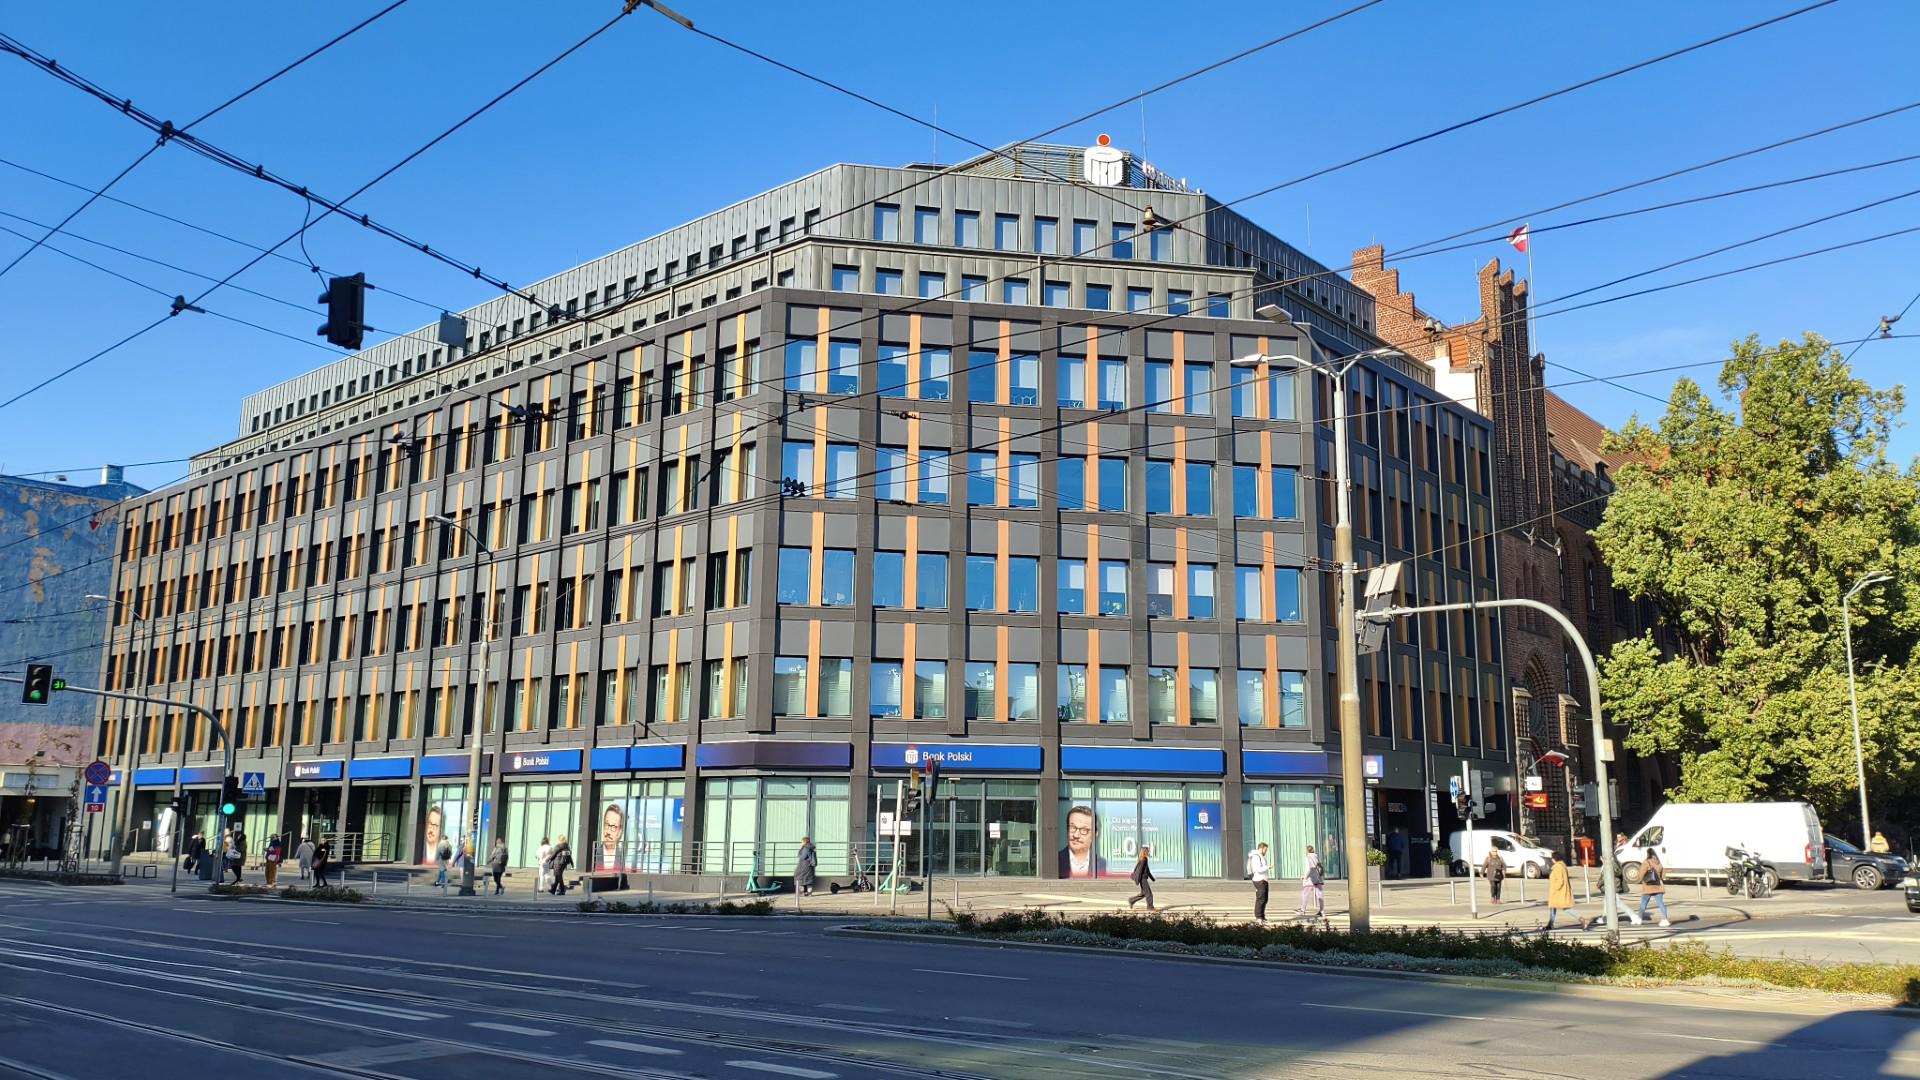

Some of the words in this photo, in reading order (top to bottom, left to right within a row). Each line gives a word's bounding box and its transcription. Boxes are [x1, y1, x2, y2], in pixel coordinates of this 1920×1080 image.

[922, 751, 945, 761] Bank
[947, 751, 973, 761] Polski
[523, 757, 535, 766] Bank
